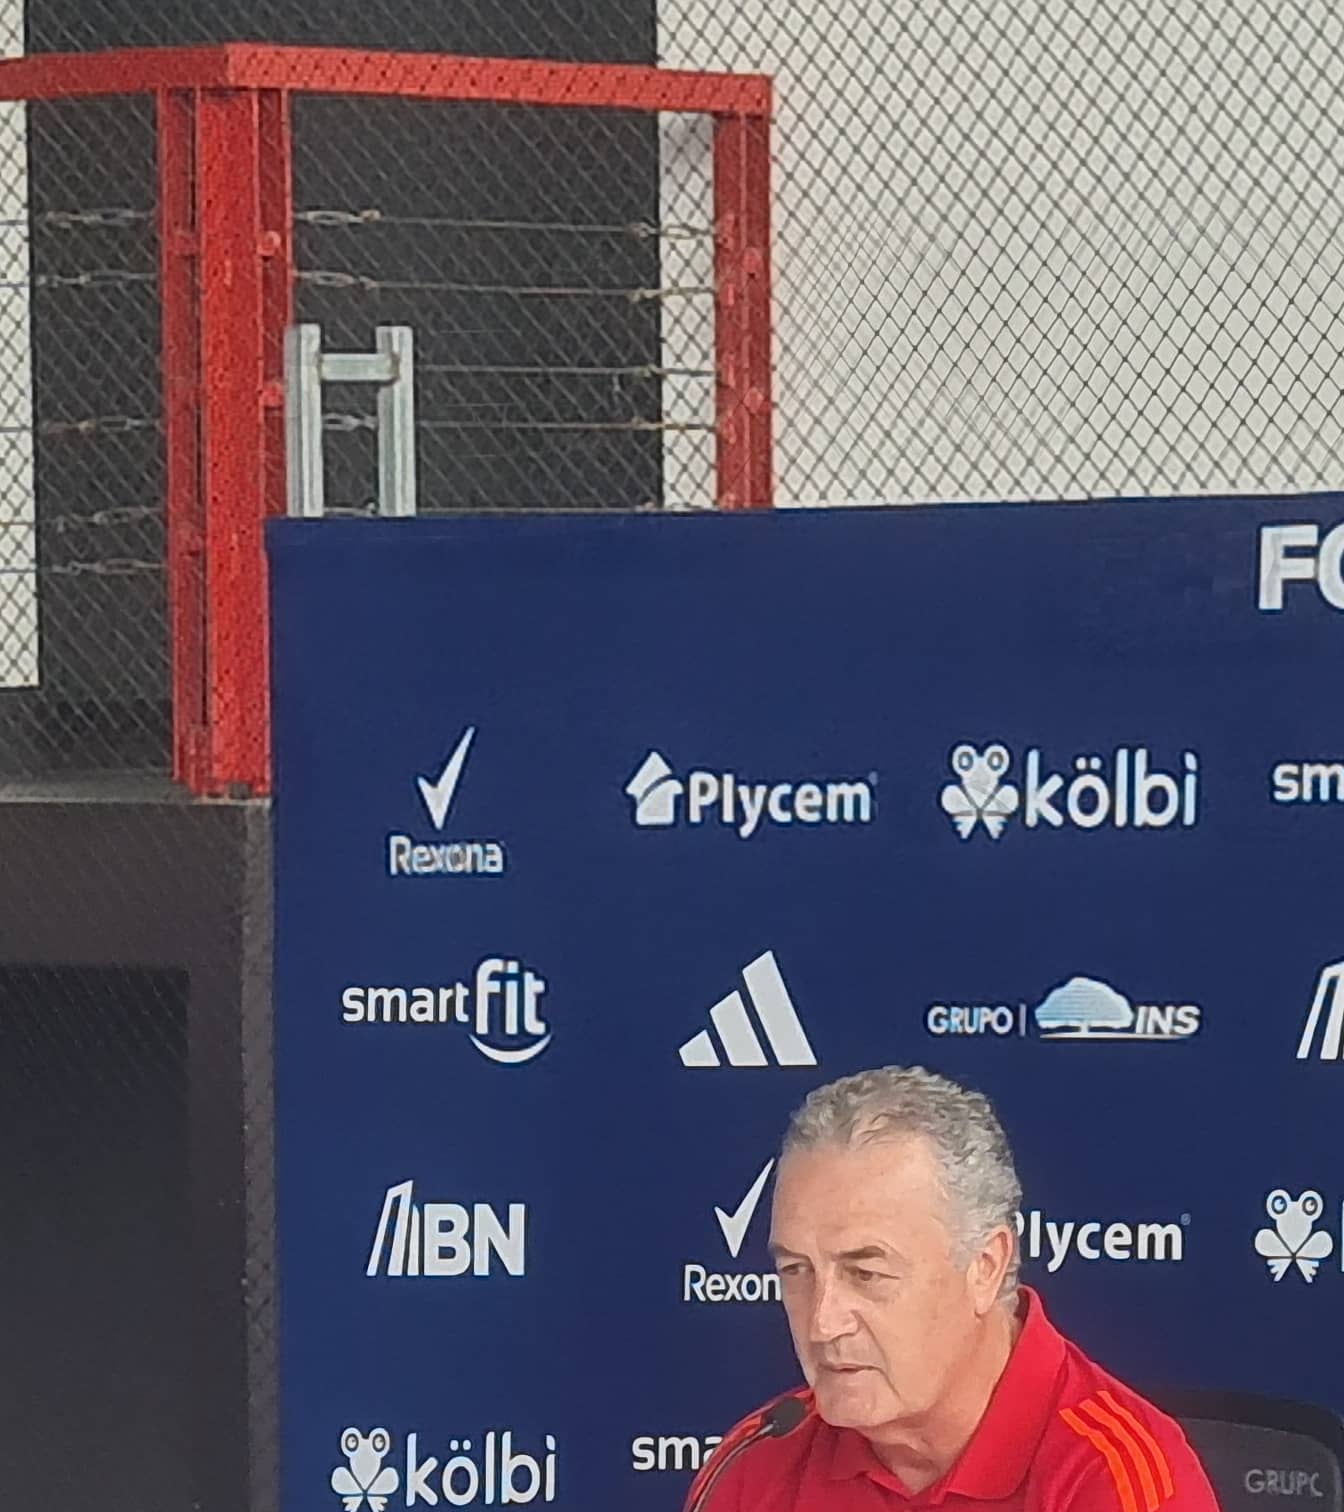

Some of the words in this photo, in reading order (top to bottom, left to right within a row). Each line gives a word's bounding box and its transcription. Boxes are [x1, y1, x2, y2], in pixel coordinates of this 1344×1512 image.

[690, 772, 870, 837] Plycem
[1026, 749, 1196, 827] kölbi
[390, 836, 503, 874] Rexona
[928, 1007, 1013, 1034] GRUPO
[1135, 1006, 1199, 1034] INS
[424, 1204, 525, 1275] BN
[684, 1264, 782, 1302] Rexon
[407, 1432, 555, 1506] kölbi
